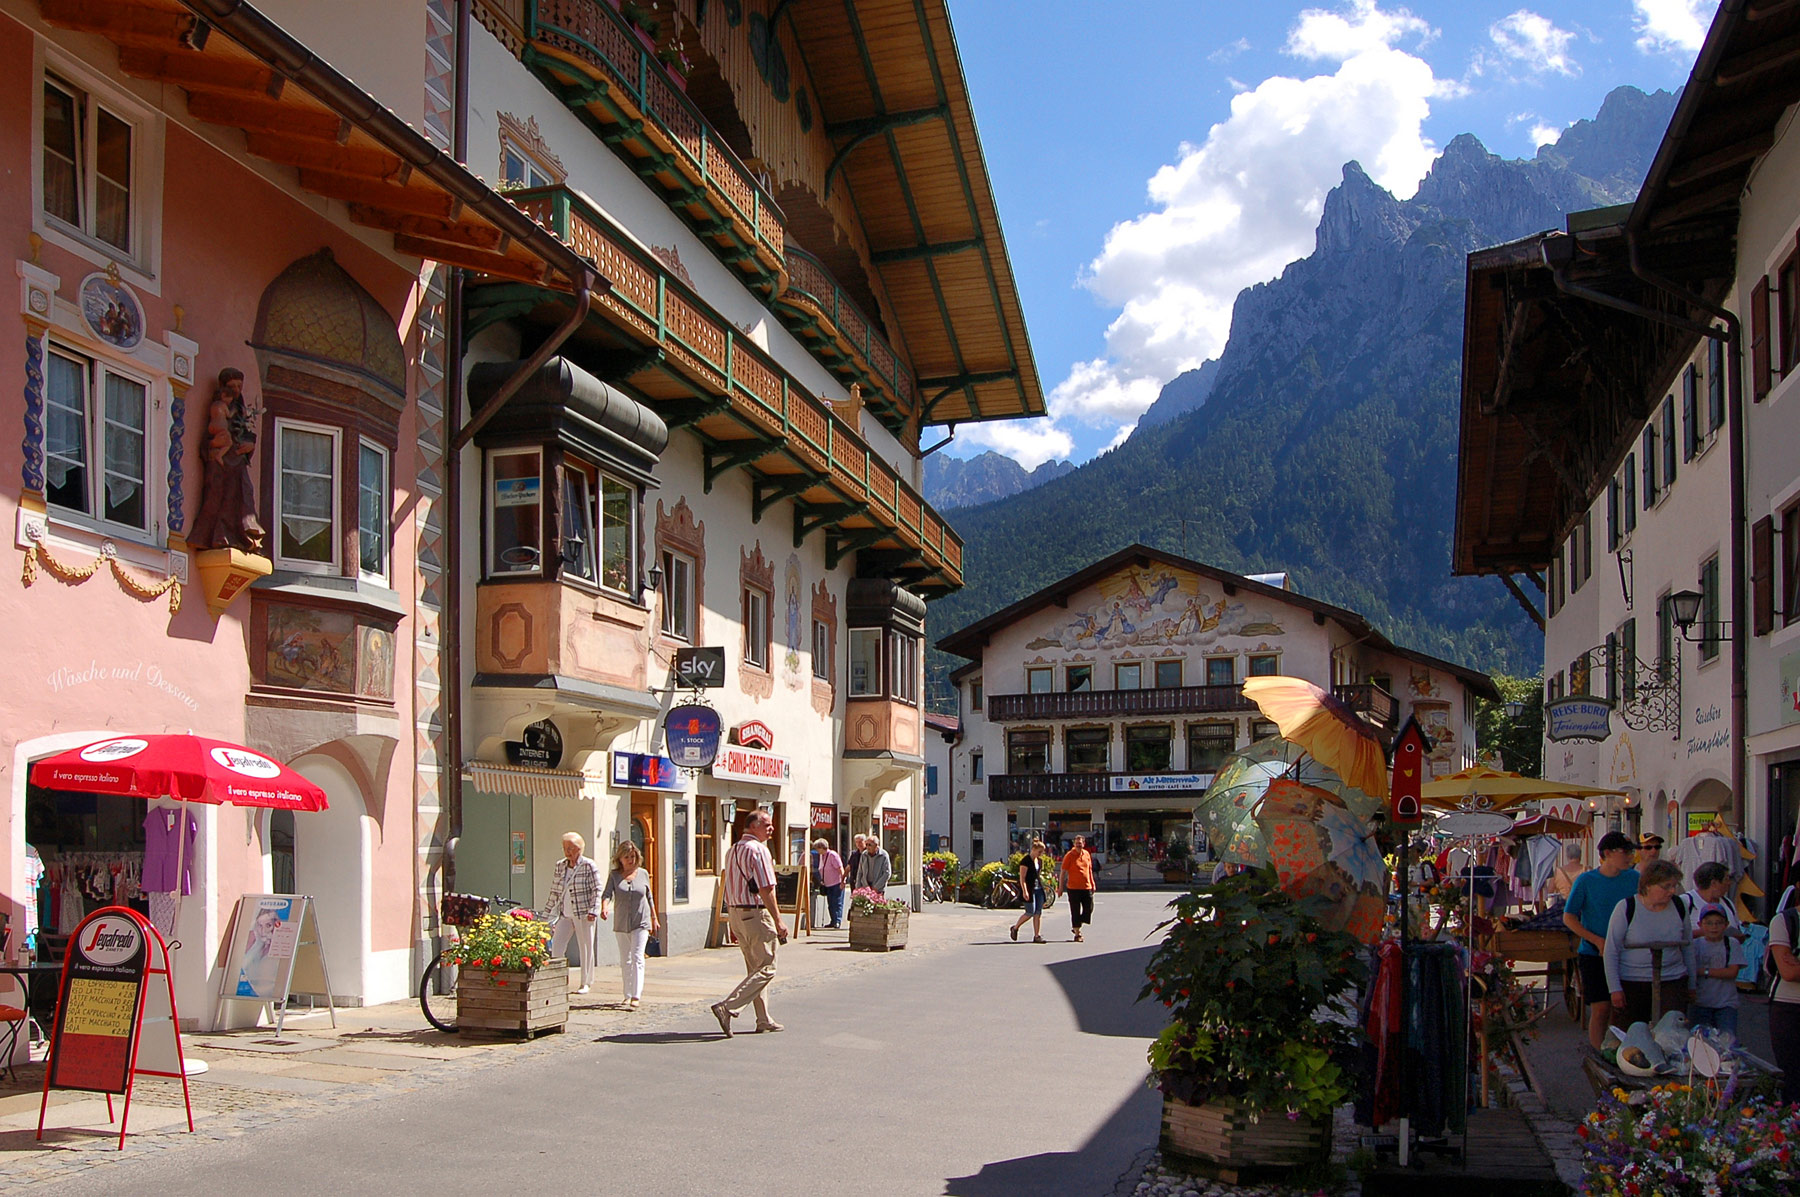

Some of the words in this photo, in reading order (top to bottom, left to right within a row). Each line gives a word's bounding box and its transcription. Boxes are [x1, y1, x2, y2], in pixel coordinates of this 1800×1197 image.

[681, 656, 716, 678] sky
[47, 659, 107, 693] Wäsche
[112, 662, 143, 681] und
[146, 665, 200, 712] Dessous
[742, 723, 772, 746] SHANGHAI
[519, 748, 545, 759] INTERNET
[728, 751, 783, 779] CHINA-RESTAURANT
[59, 772, 73, 780] vero
[74, 773, 99, 783] espresso
[99, 773, 119, 783] italiano
[233, 788, 248, 796] vero
[248, 788, 275, 799] espresso
[276, 789, 302, 801] italiano
[85, 924, 134, 951] Segafredo
[115, 966, 136, 974] italiano
[88, 981, 118, 989] ESPRESSO
[66, 1017, 87, 1025] LATTE
